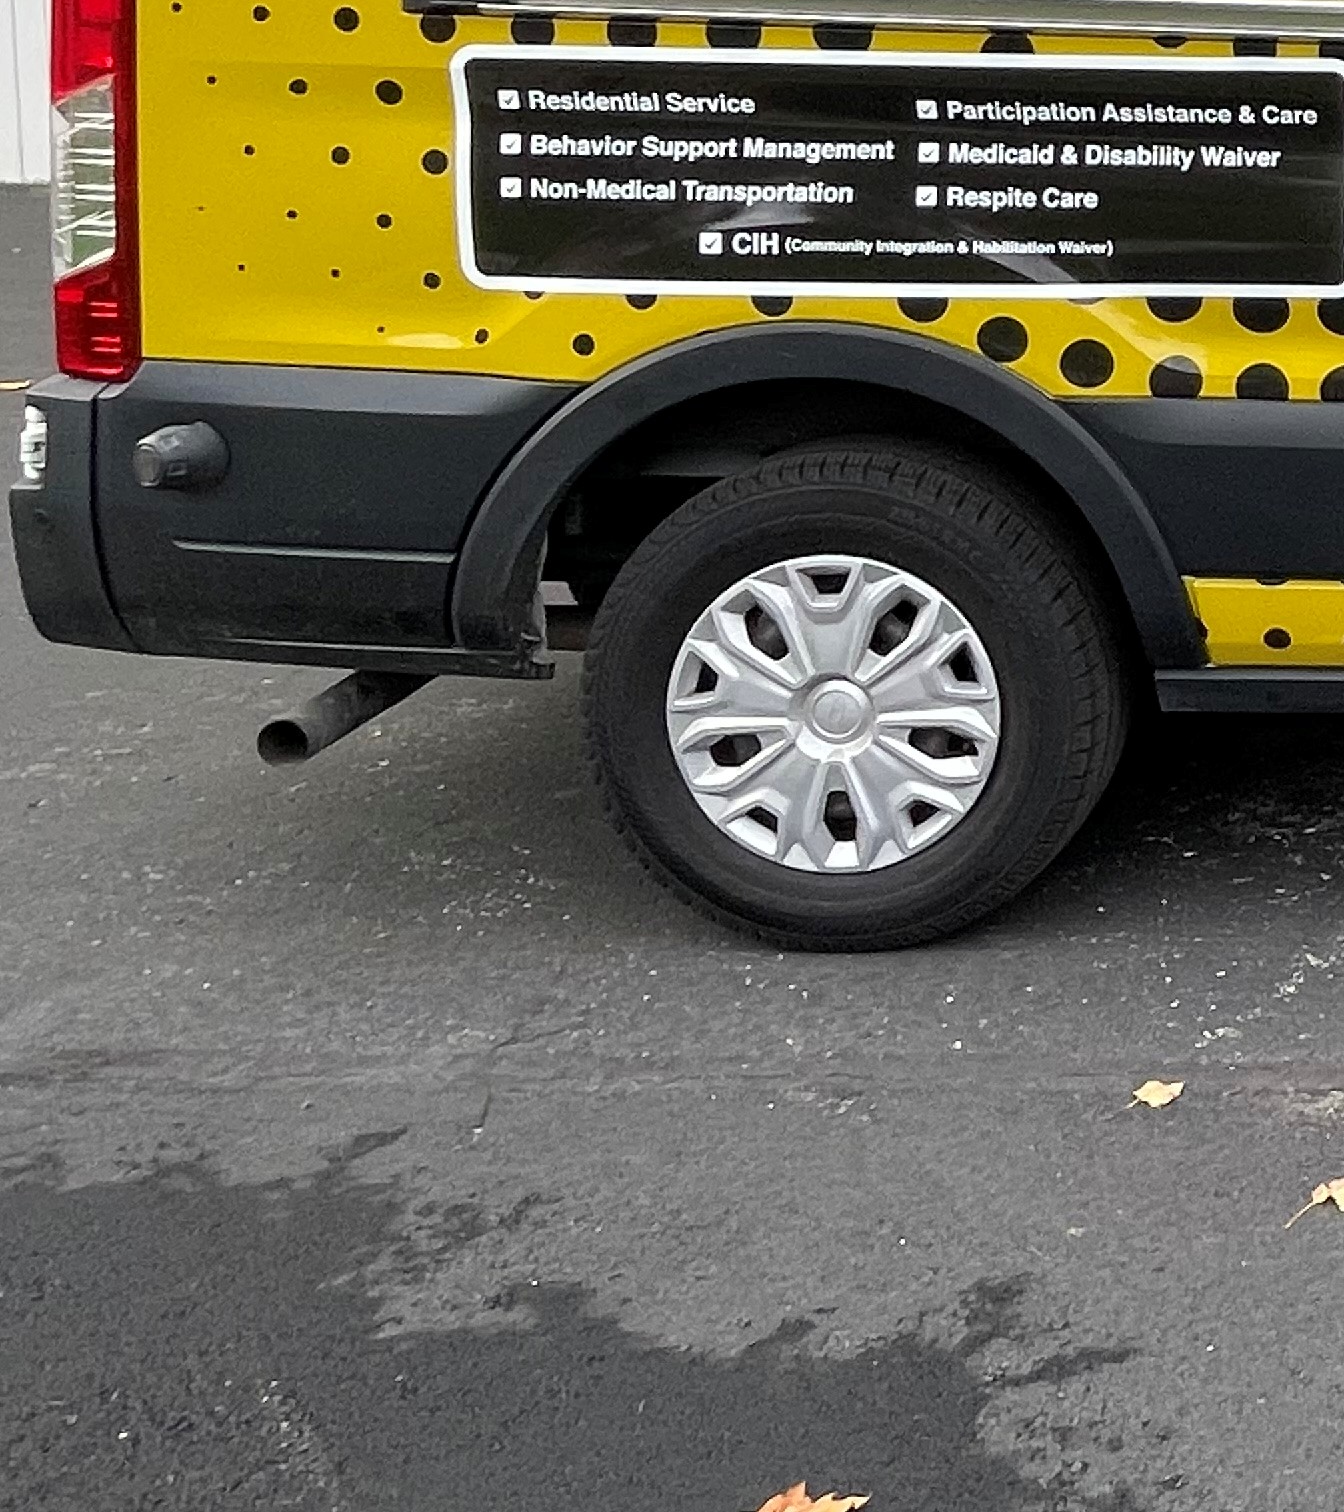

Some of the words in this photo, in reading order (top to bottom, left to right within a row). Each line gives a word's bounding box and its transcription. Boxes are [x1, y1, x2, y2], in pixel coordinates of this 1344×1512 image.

[527, 89, 660, 112] Residential
[665, 92, 755, 114] Service
[946, 100, 1096, 126] Participation
[1102, 102, 1232, 124] Assistance
[1238, 104, 1256, 124] &
[1262, 104, 1318, 126] Care
[530, 134, 637, 156] Behavior
[641, 135, 738, 162] Support
[742, 137, 895, 164] Management
[948, 142, 1055, 165] Medicaid
[1060, 144, 1078, 166] &
[1084, 144, 1195, 172] Disability
[1200, 146, 1282, 168] Waiver
[530, 178, 676, 201] Non-Medical
[680, 180, 854, 207] Transportation
[946, 186, 1038, 213] Respite
[1042, 186, 1099, 209] Care
[731, 232, 780, 256] CIH
[784, 236, 873, 256] (Community
[876, 239, 955, 256] Integration
[956, 240, 970, 255] &
[972, 240, 1056, 255] Habilitation
[1057, 239, 1114, 257] Waiver)
